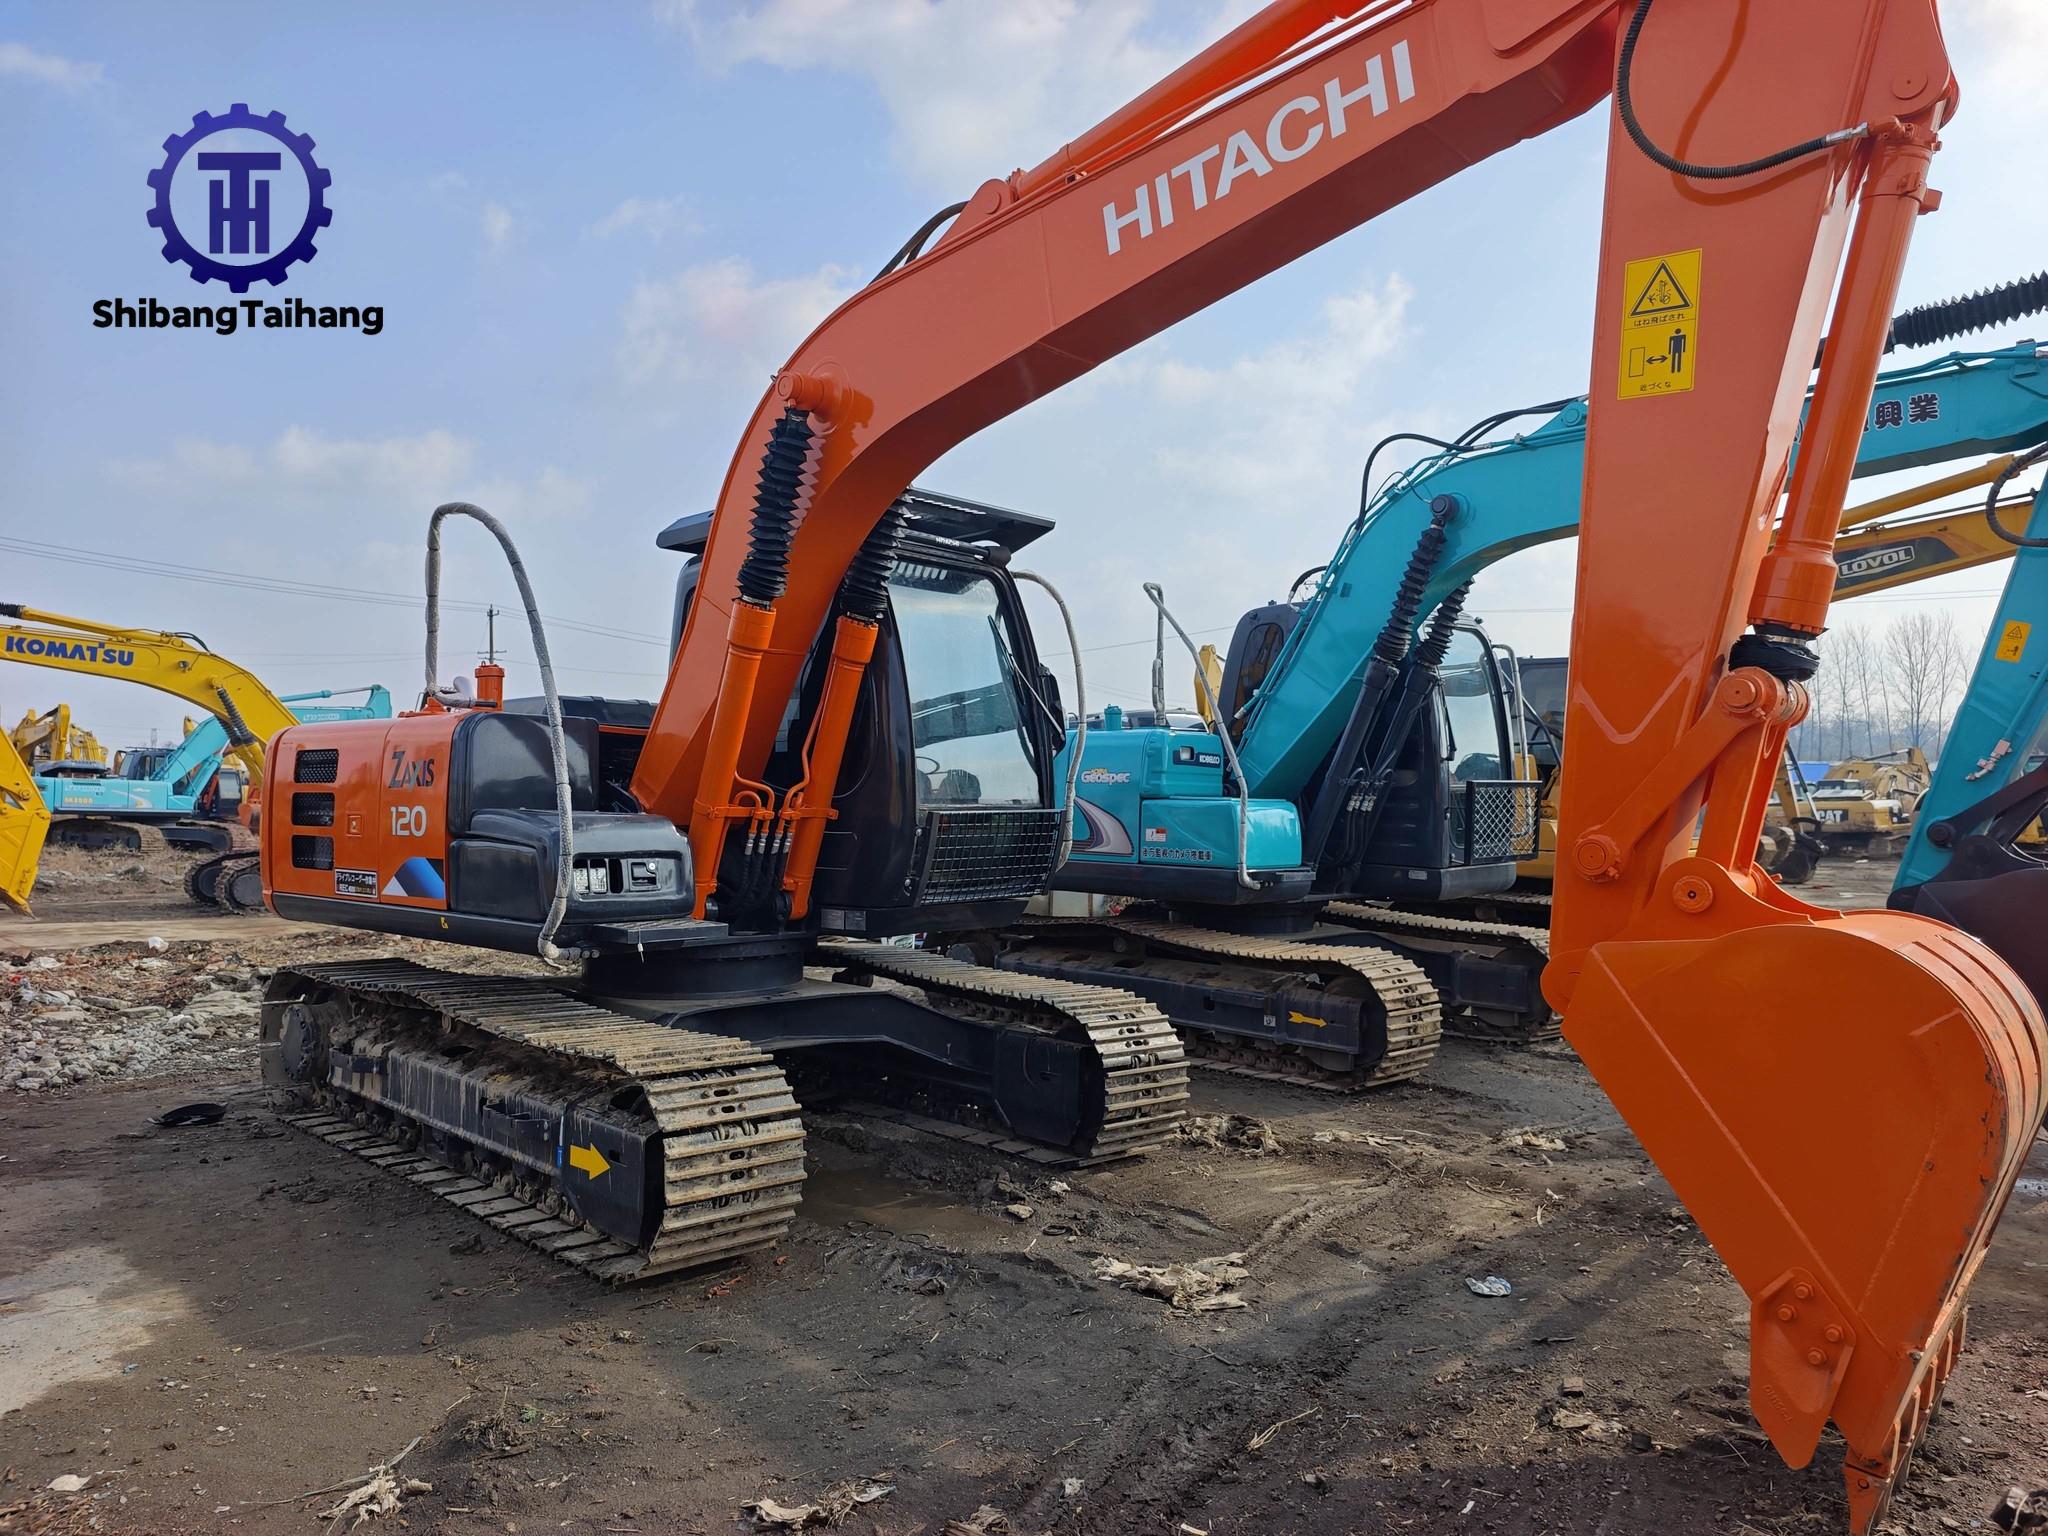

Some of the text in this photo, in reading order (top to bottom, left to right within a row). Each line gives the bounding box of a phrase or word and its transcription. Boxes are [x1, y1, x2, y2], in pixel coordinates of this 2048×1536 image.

[1103, 39, 1416, 256] HITACHI
[1864, 393, 1939, 431] 興業
[1841, 549, 1912, 575] LOVOL
[5, 635, 135, 666] KOMATSU
[390, 805, 428, 837] 120
[1817, 810, 1843, 823] CAT
